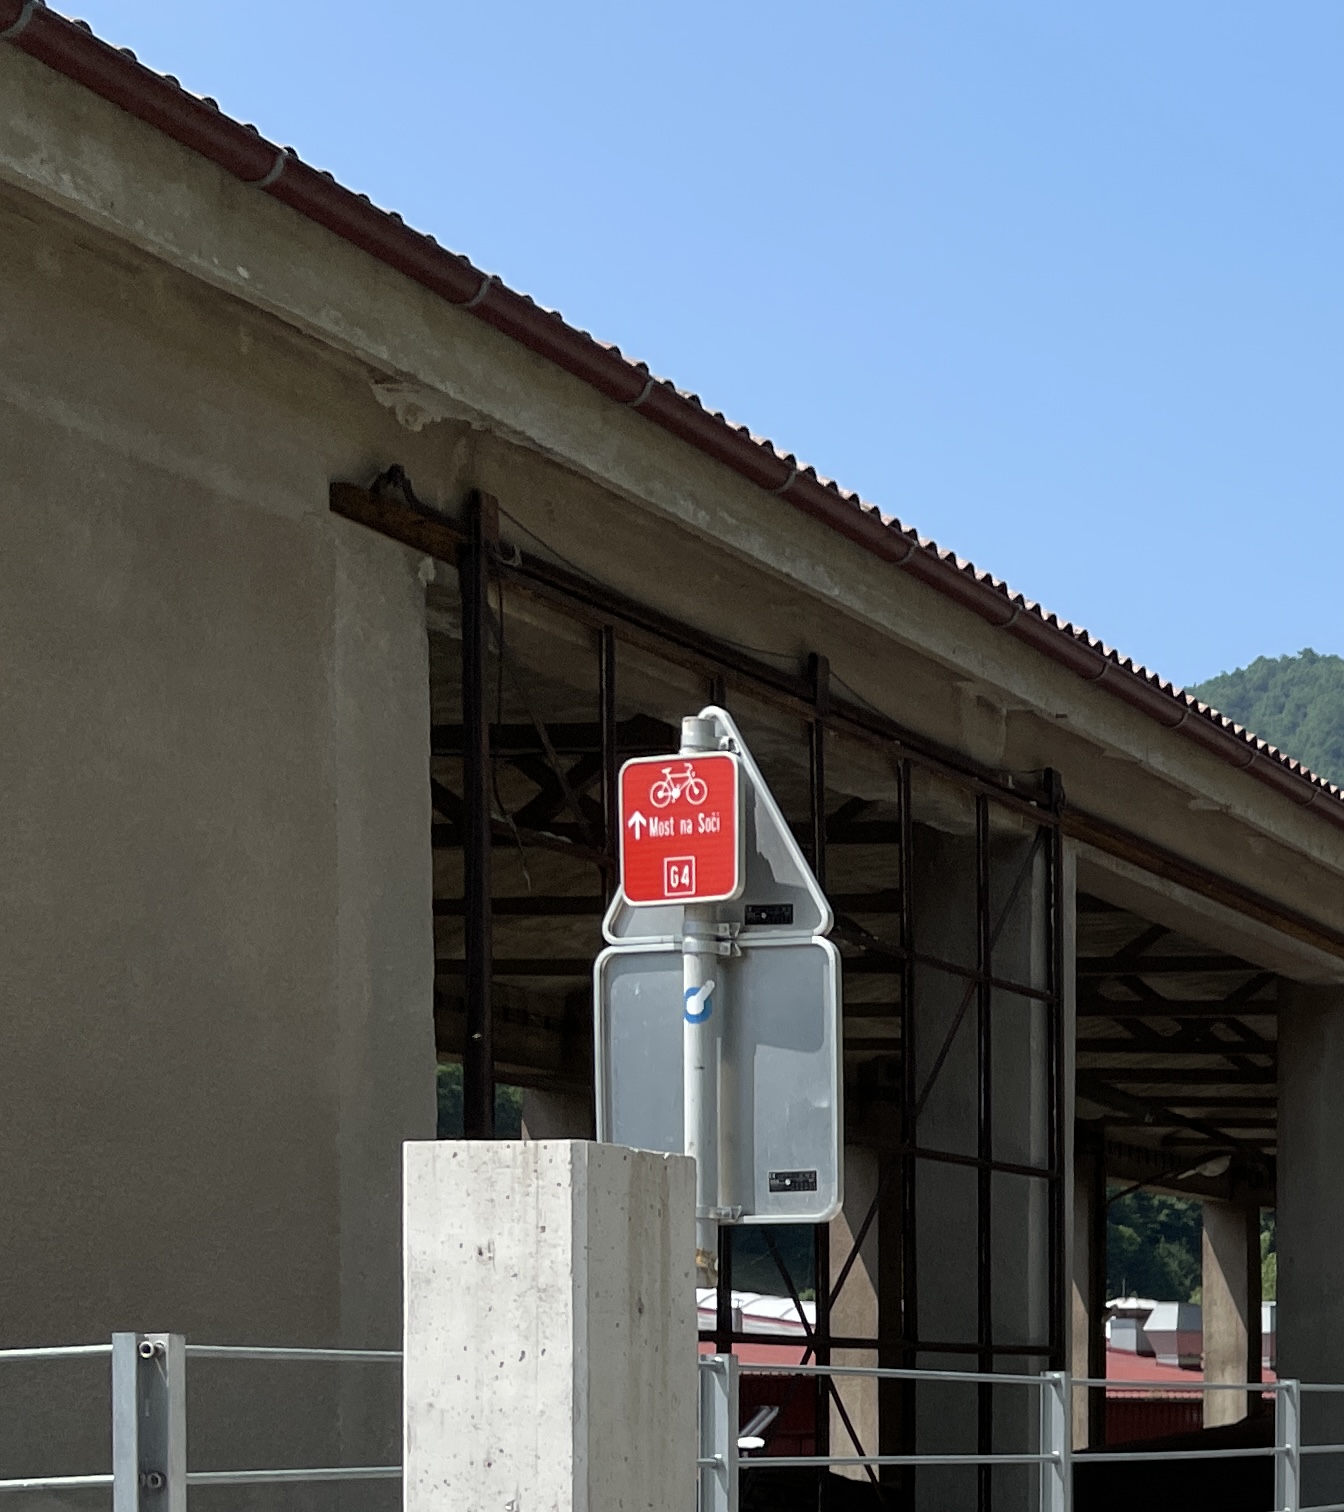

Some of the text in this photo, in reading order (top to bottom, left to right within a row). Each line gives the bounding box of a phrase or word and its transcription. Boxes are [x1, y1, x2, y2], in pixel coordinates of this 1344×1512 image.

[649, 811, 720, 838] Most na Soči
[670, 864, 690, 888] G4
